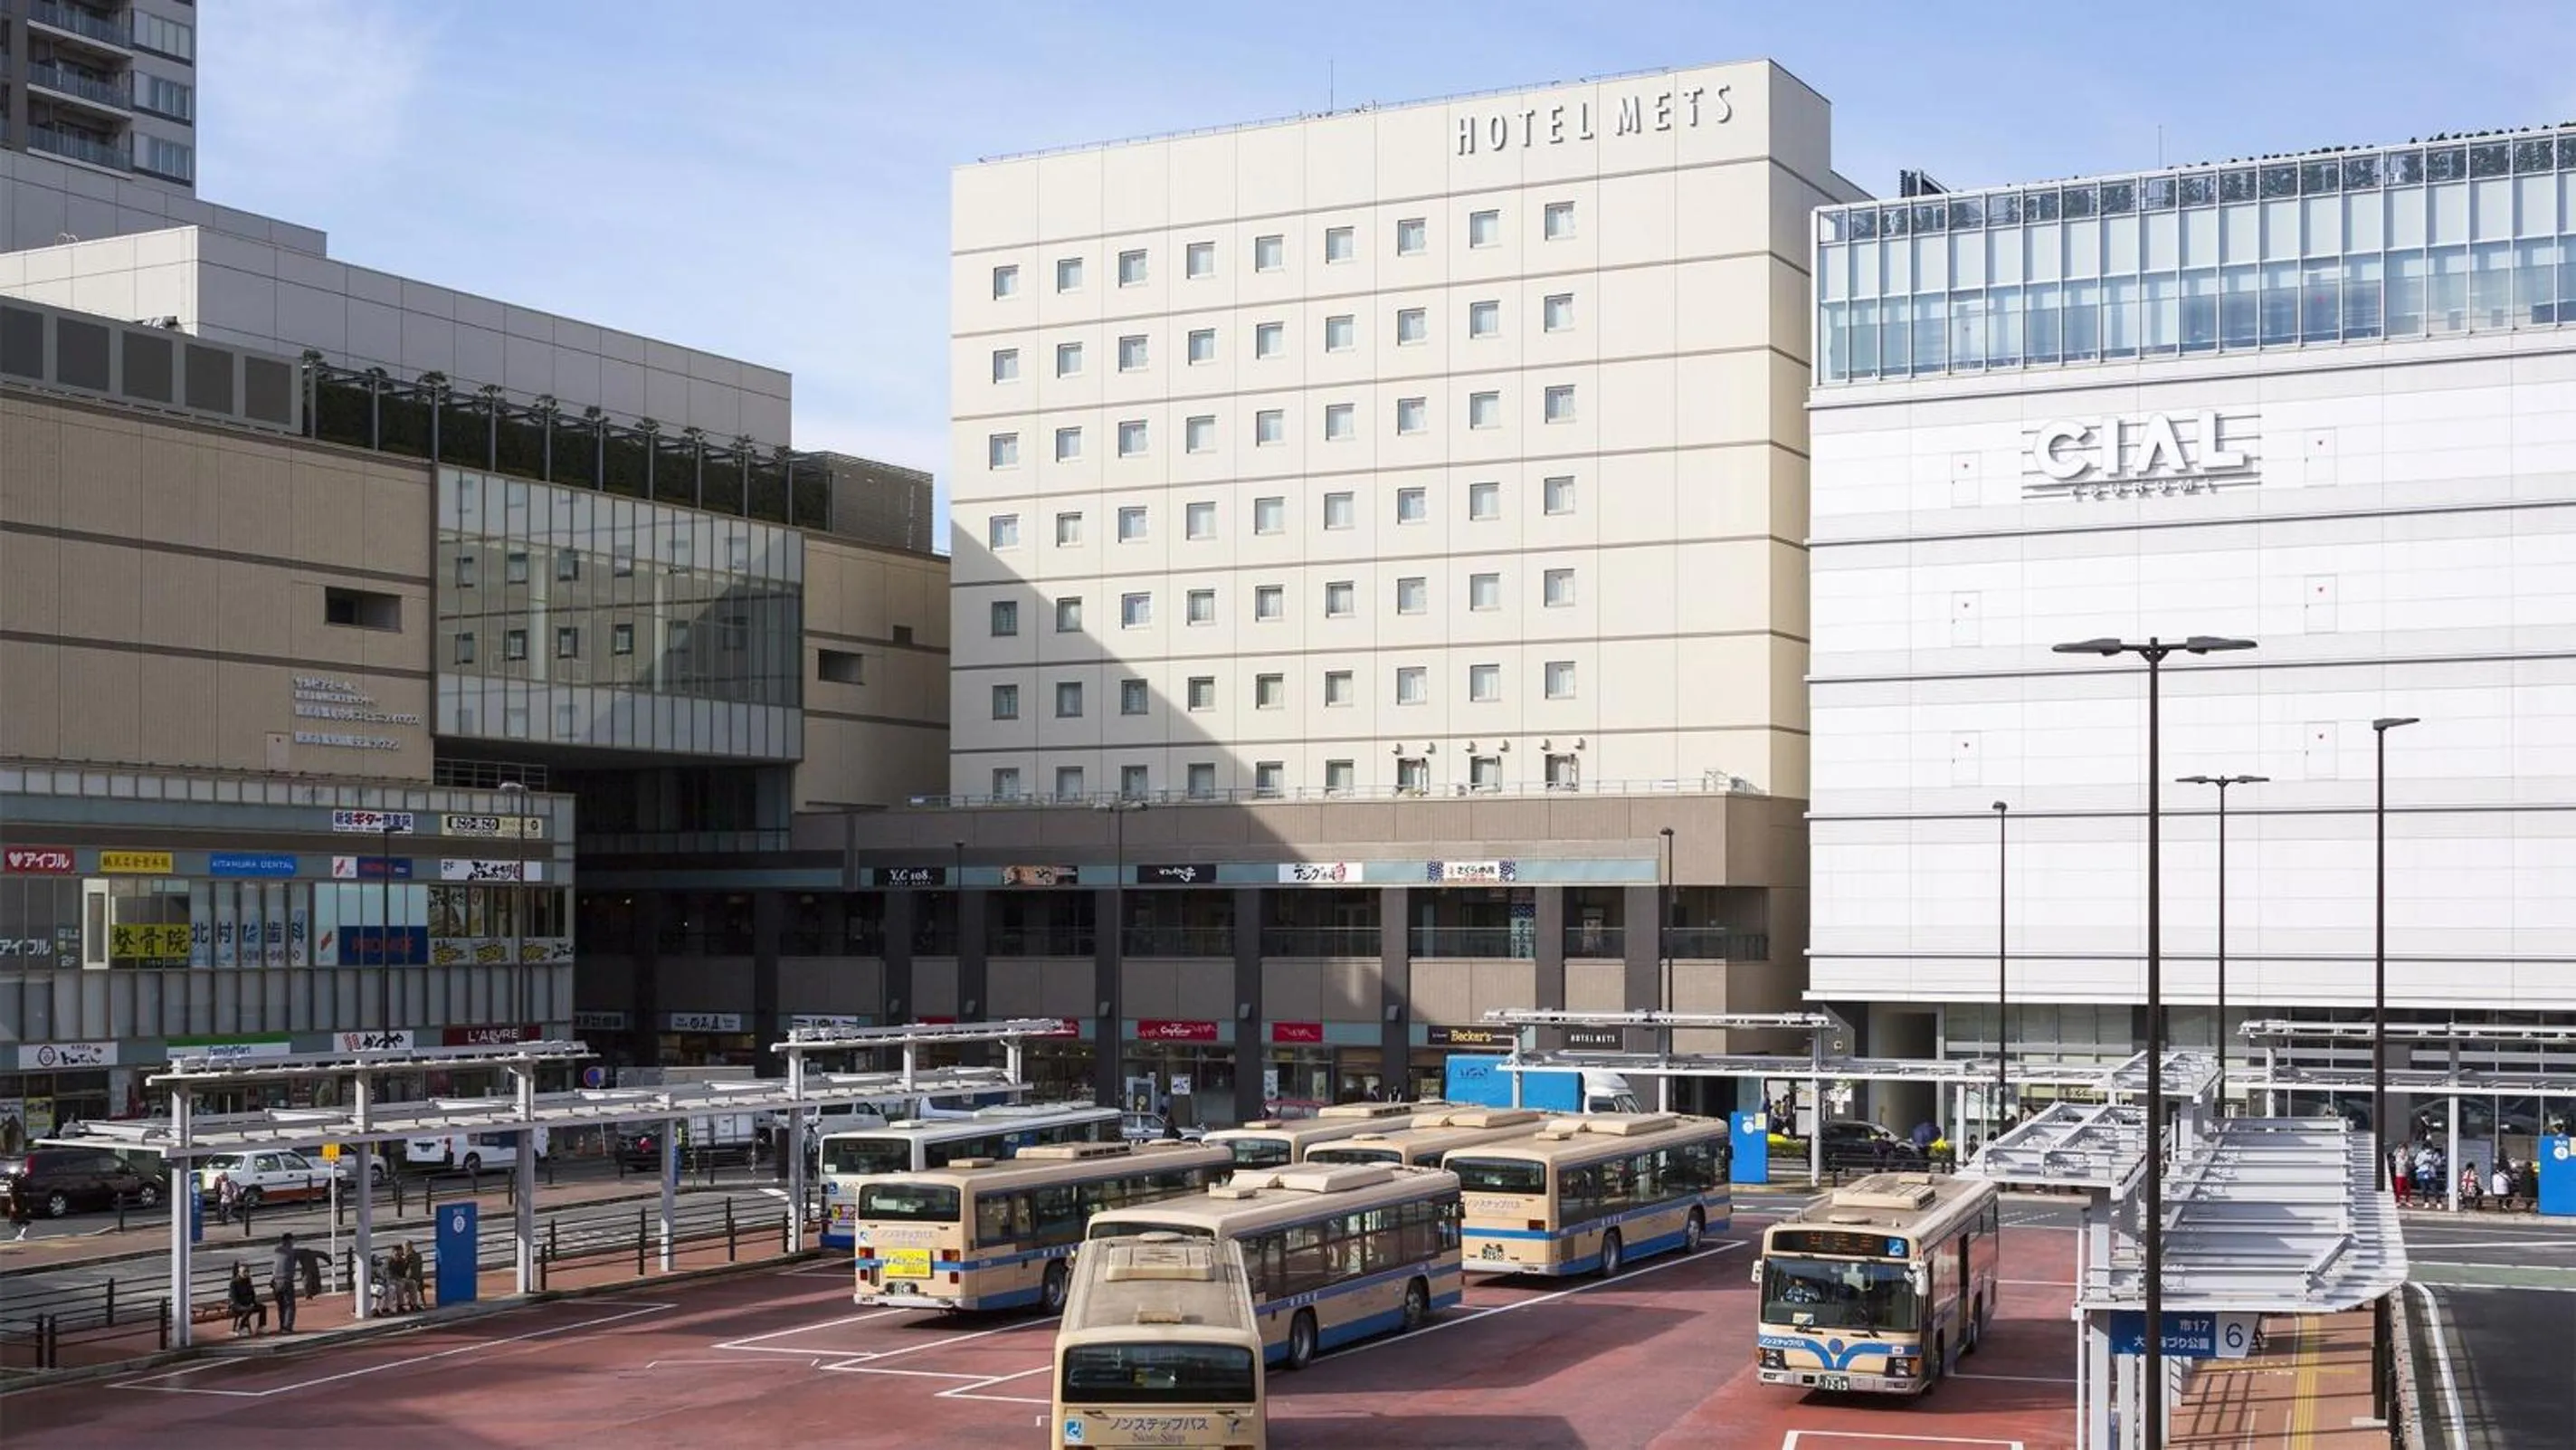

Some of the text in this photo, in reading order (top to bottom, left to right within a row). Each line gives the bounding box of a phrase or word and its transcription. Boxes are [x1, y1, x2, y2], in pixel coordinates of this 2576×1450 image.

[1457, 85, 1732, 155] HOTEL METS
[2033, 410, 2248, 481] CIAL
[24, 852, 70, 868] アイフル
[0, 939, 52, 956] アイフル
[114, 926, 188, 956] 整骨院
[1450, 1030, 1492, 1043] Becker's
[207, 1045, 251, 1059] FamilyMart
[2179, 1319, 2210, 1332] 市17
[2225, 1322, 2244, 1349] 6
[1109, 1417, 1210, 1432] ノンステップバス
